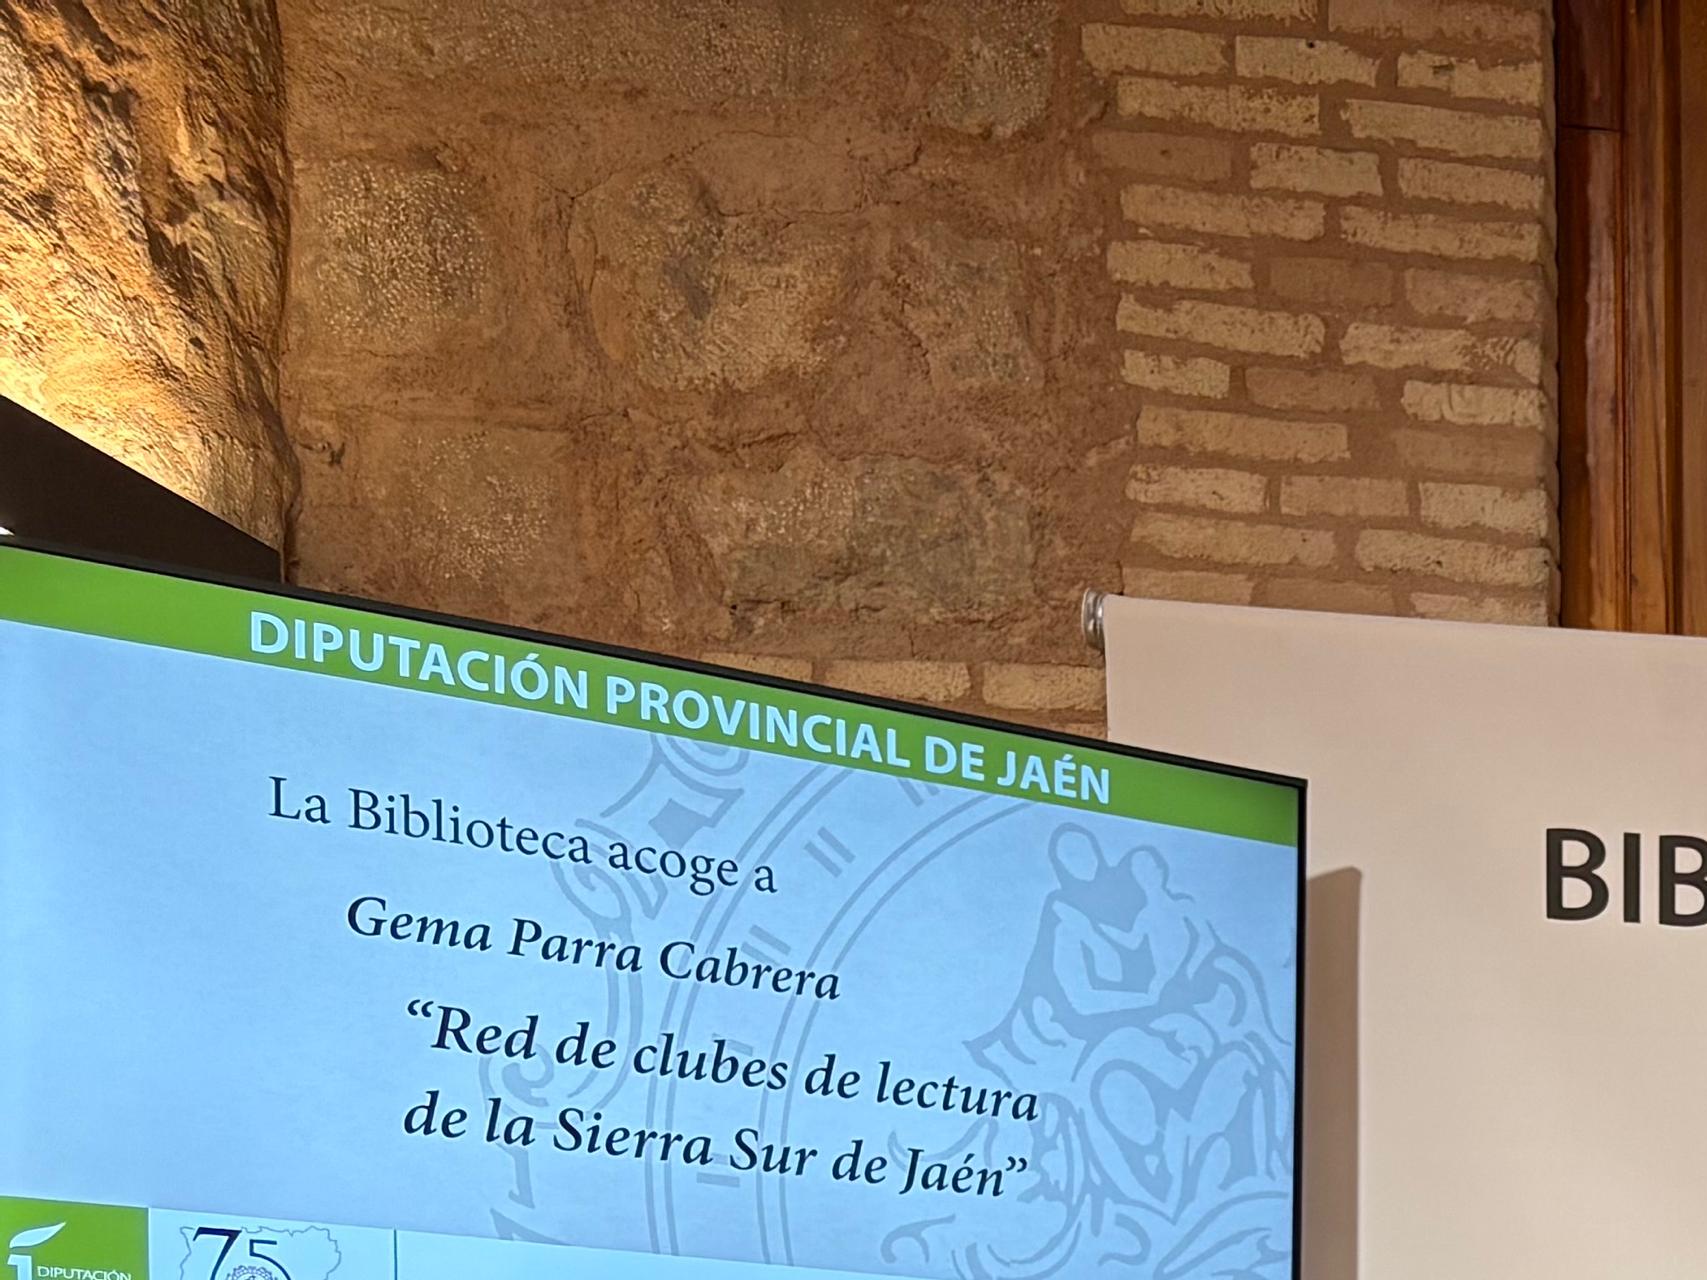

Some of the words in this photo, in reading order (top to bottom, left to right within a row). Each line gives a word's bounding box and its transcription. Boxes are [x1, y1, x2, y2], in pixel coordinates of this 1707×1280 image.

[250, 609, 588, 708] DIPUTACIÓN
[606, 676, 910, 768] PROVINCIAL
[925, 736, 984, 781] DE
[997, 751, 1109, 804] JAÉN
[269, 776, 330, 824] La
[348, 788, 592, 864] Biblioteca
[609, 842, 738, 896] acoge
[755, 866, 777, 893] a
[348, 897, 492, 951] Gema
[507, 918, 642, 972] Parra
[660, 942, 840, 1000] Cabrera
[556, 1022, 616, 1068] de
[634, 1033, 788, 1090] clubes
[805, 1054, 860, 1098] de
[877, 1061, 1038, 1121] lectura
[404, 1090, 467, 1138] de
[486, 1098, 535, 1146] la
[554, 1108, 713, 1165] Sierra
[730, 1128, 817, 1175] Sur
[832, 1140, 887, 1184] de
